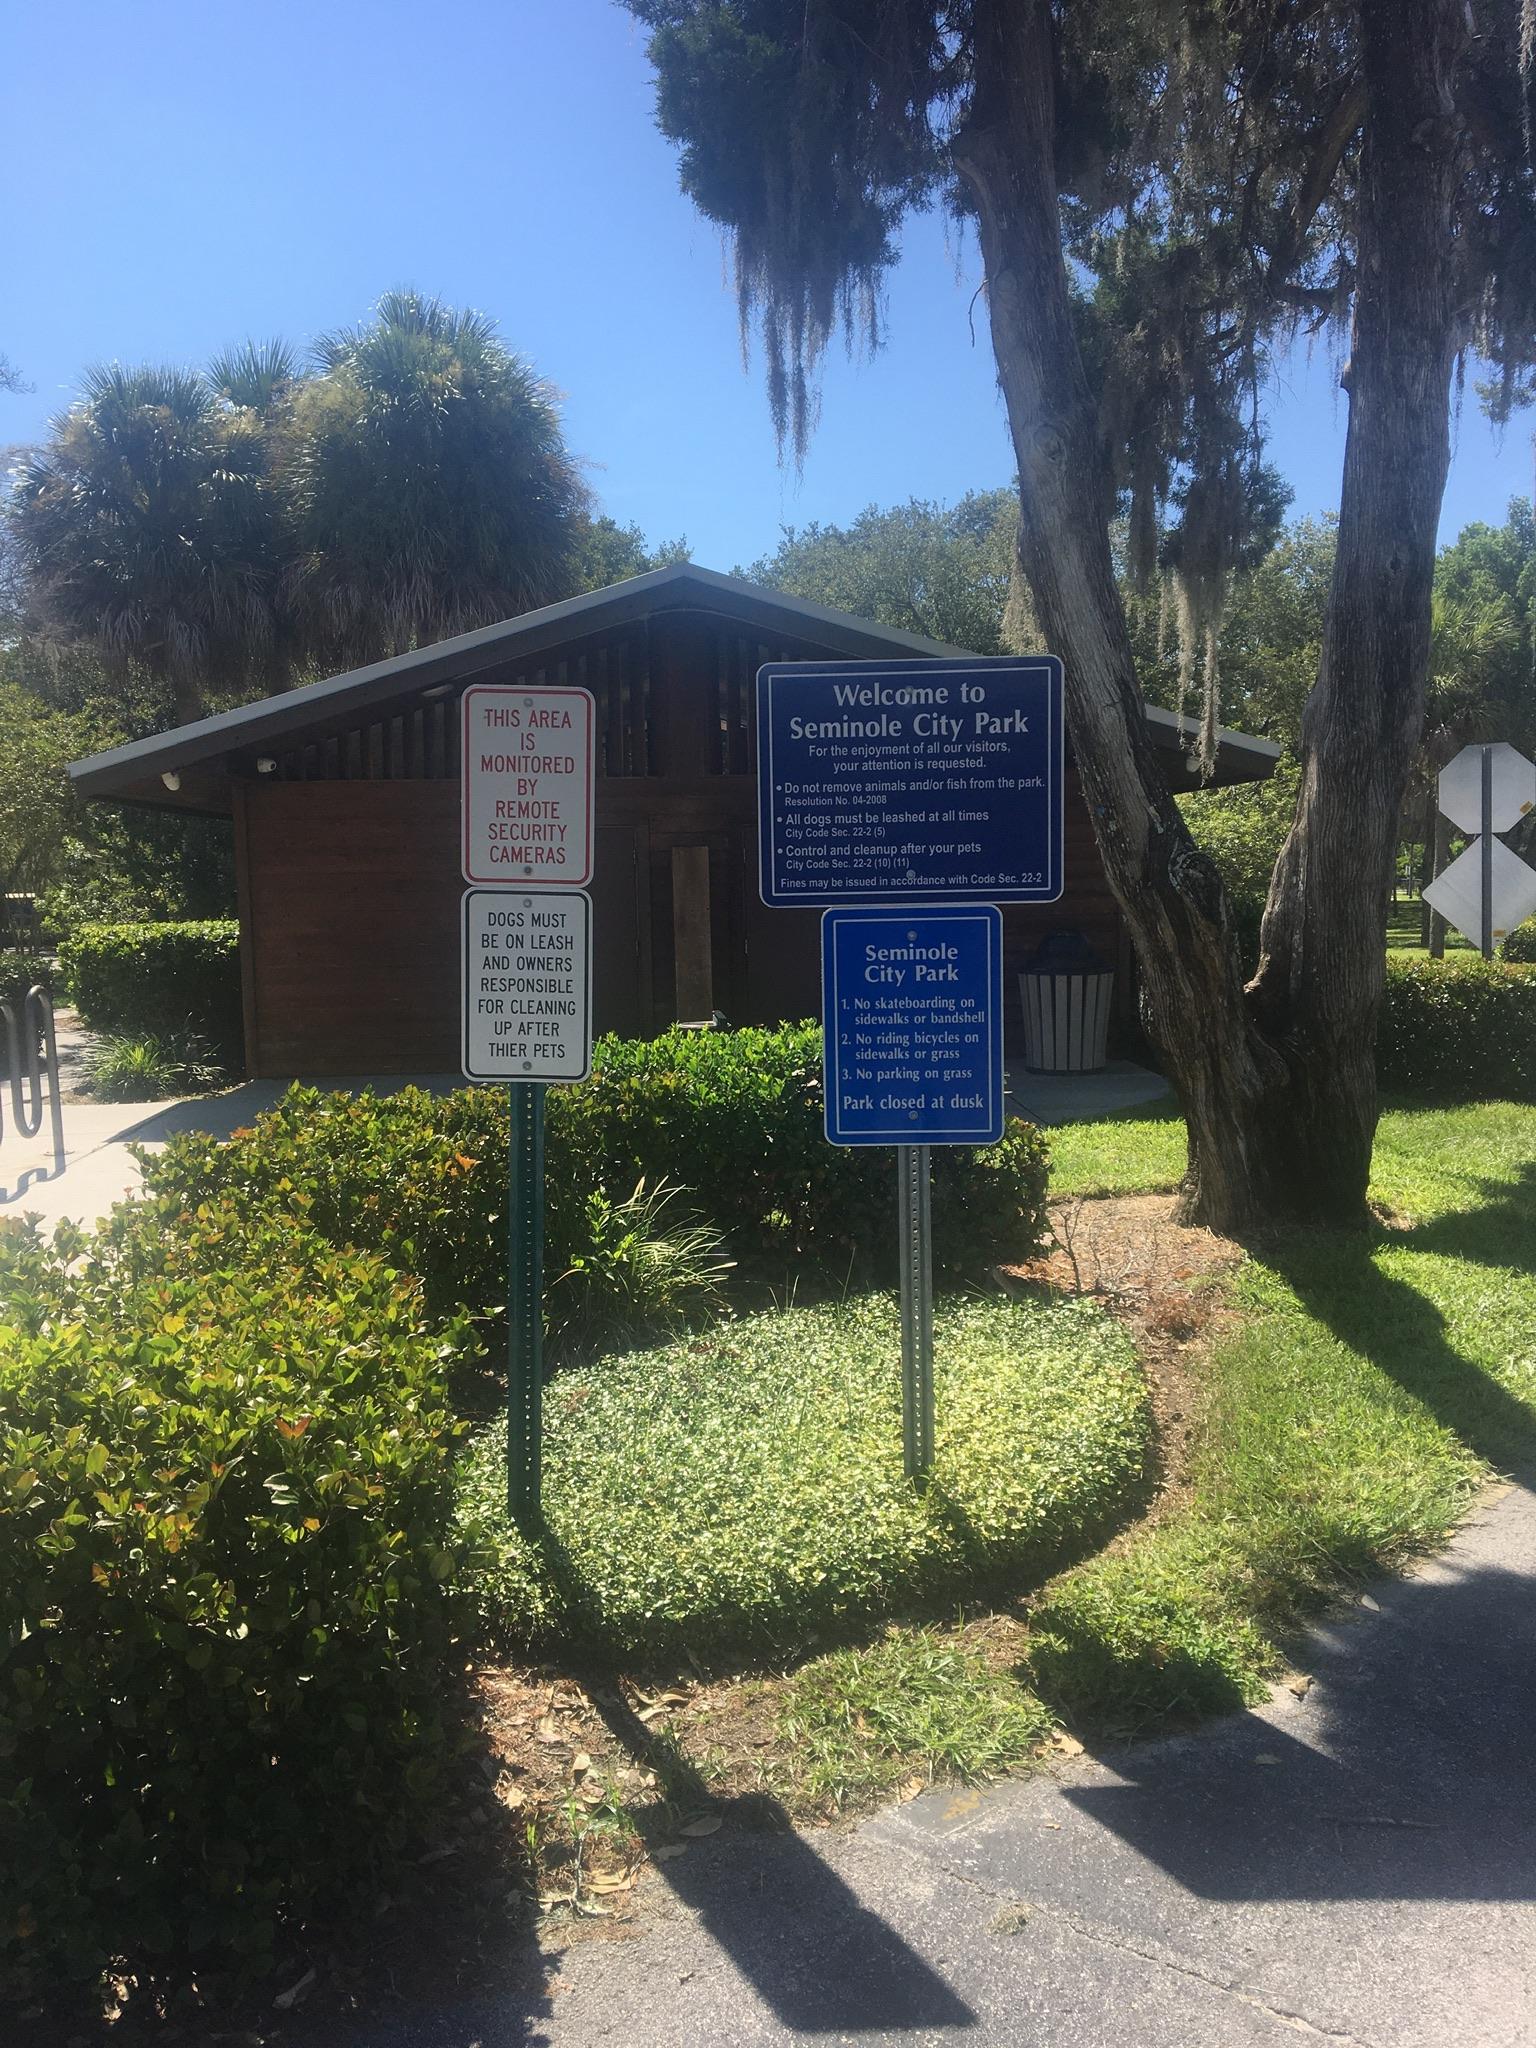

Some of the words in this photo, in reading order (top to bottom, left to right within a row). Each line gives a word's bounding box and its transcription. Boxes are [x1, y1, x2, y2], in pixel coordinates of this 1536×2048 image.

[833, 682, 949, 706] Welcome
[960, 682, 986, 703] to
[484, 709, 520, 727] THIS
[528, 710, 572, 728] AREA
[790, 714, 902, 739] Seminole
[913, 712, 963, 742] City
[975, 709, 1029, 734] Park
[521, 733, 535, 750] IS
[809, 745, 828, 757] For
[830, 744, 848, 756] the
[851, 743, 910, 758] enjoyment
[912, 742, 924, 754] of
[927, 742, 940, 754] all
[944, 743, 962, 754] our
[481, 755, 574, 773] MONITORED
[833, 761, 859, 774] your
[862, 758, 911, 770] attention
[914, 758, 924, 769] is
[928, 756, 987, 771] requested.
[518, 779, 538, 795] BY
[784, 782, 799, 794] Do
[802, 783, 820, 793] not
[822, 782, 862, 792] remove
[865, 780, 906, 792] animals
[910, 780, 944, 791] and/or
[946, 778, 967, 790] fish
[970, 778, 995, 789] from
[998, 777, 1015, 788] the
[1018, 776, 1045, 790] park.
[785, 796, 832, 806] Resolution
[836, 796, 850, 805] No.
[852, 795, 887, 805] 04-2008
[496, 801, 560, 819] REMOTE
[786, 814, 800, 825] All
[804, 814, 832, 827] dogs
[834, 812, 862, 824] must
[866, 812, 880, 823] be
[882, 811, 926, 822] leashed
[928, 811, 939, 822] at
[942, 810, 955, 822] all
[958, 810, 990, 820] times
[488, 823, 567, 842] SECURITY
[786, 828, 803, 838] City
[806, 828, 829, 838] Code
[832, 828, 850, 837] Sec.
[852, 827, 872, 836] 22-2
[874, 826, 886, 838] (5)
[490, 846, 566, 864] CAMERAS
[786, 845, 828, 856] Control
[830, 844, 850, 856] and
[854, 844, 898, 856] cleanup
[900, 842, 926, 854] after
[928, 844, 955, 856] your
[958, 842, 982, 855] pets
[786, 860, 804, 870] City
[806, 860, 830, 869] Code
[832, 859, 851, 869] Sec.
[853, 858, 872, 868] 22-2
[874, 858, 891, 869] (10)
[894, 858, 910, 868] (11)
[781, 879, 806, 888] Fines
[809, 878, 828, 889] may
[831, 878, 843, 887] be
[846, 876, 877, 886] issued
[880, 876, 888, 886] in
[890, 875, 946, 886] accordance
[948, 874, 968, 884] with
[970, 874, 996, 884] Code
[998, 873, 1019, 883] Sec.
[1022, 872, 1042, 882] 22-2
[488, 912, 524, 927] DOGS
[531, 913, 566, 928] MUST
[482, 934, 498, 948] BE
[506, 934, 524, 949] ON
[531, 935, 573, 950] LEASH
[866, 943, 959, 962] Seminole
[483, 956, 509, 970] AND
[517, 957, 572, 972] OWNERS
[864, 965, 905, 986] City
[915, 964, 959, 982] Park
[481, 978, 573, 993] RESPONSIBLE
[478, 999, 503, 1014] FOR
[511, 1000, 576, 1015] CLEANING
[841, 999, 850, 1010] 1.
[854, 998, 870, 1009] No
[875, 997, 956, 1011] skateboarding
[960, 998, 975, 1008] on
[855, 1012, 909, 1025] sidewalks
[914, 1014, 926, 1024] or
[931, 1011, 985, 1023] bandshell
[494, 1021, 512, 1035] UP
[518, 1022, 559, 1036] AFTER
[841, 1033, 851, 1045] 2.
[856, 1033, 872, 1044] No
[877, 1032, 910, 1047] riding
[914, 1031, 959, 1045] bicycles
[964, 1033, 979, 1044] on
[489, 1043, 527, 1057] THIER
[534, 1044, 565, 1058] PETS
[855, 1047, 909, 1060] sidewalks
[914, 1049, 926, 1059] or
[931, 1049, 960, 1062] grass
[842, 1068, 852, 1080] 3.
[856, 1068, 873, 1079] No
[877, 1067, 920, 1082] parking
[924, 1068, 939, 1079] on
[943, 1068, 973, 1082] grass
[843, 1096, 874, 1110] Park
[880, 1094, 925, 1109] closed
[931, 1095, 944, 1109] at
[950, 1094, 984, 1109] dusk
